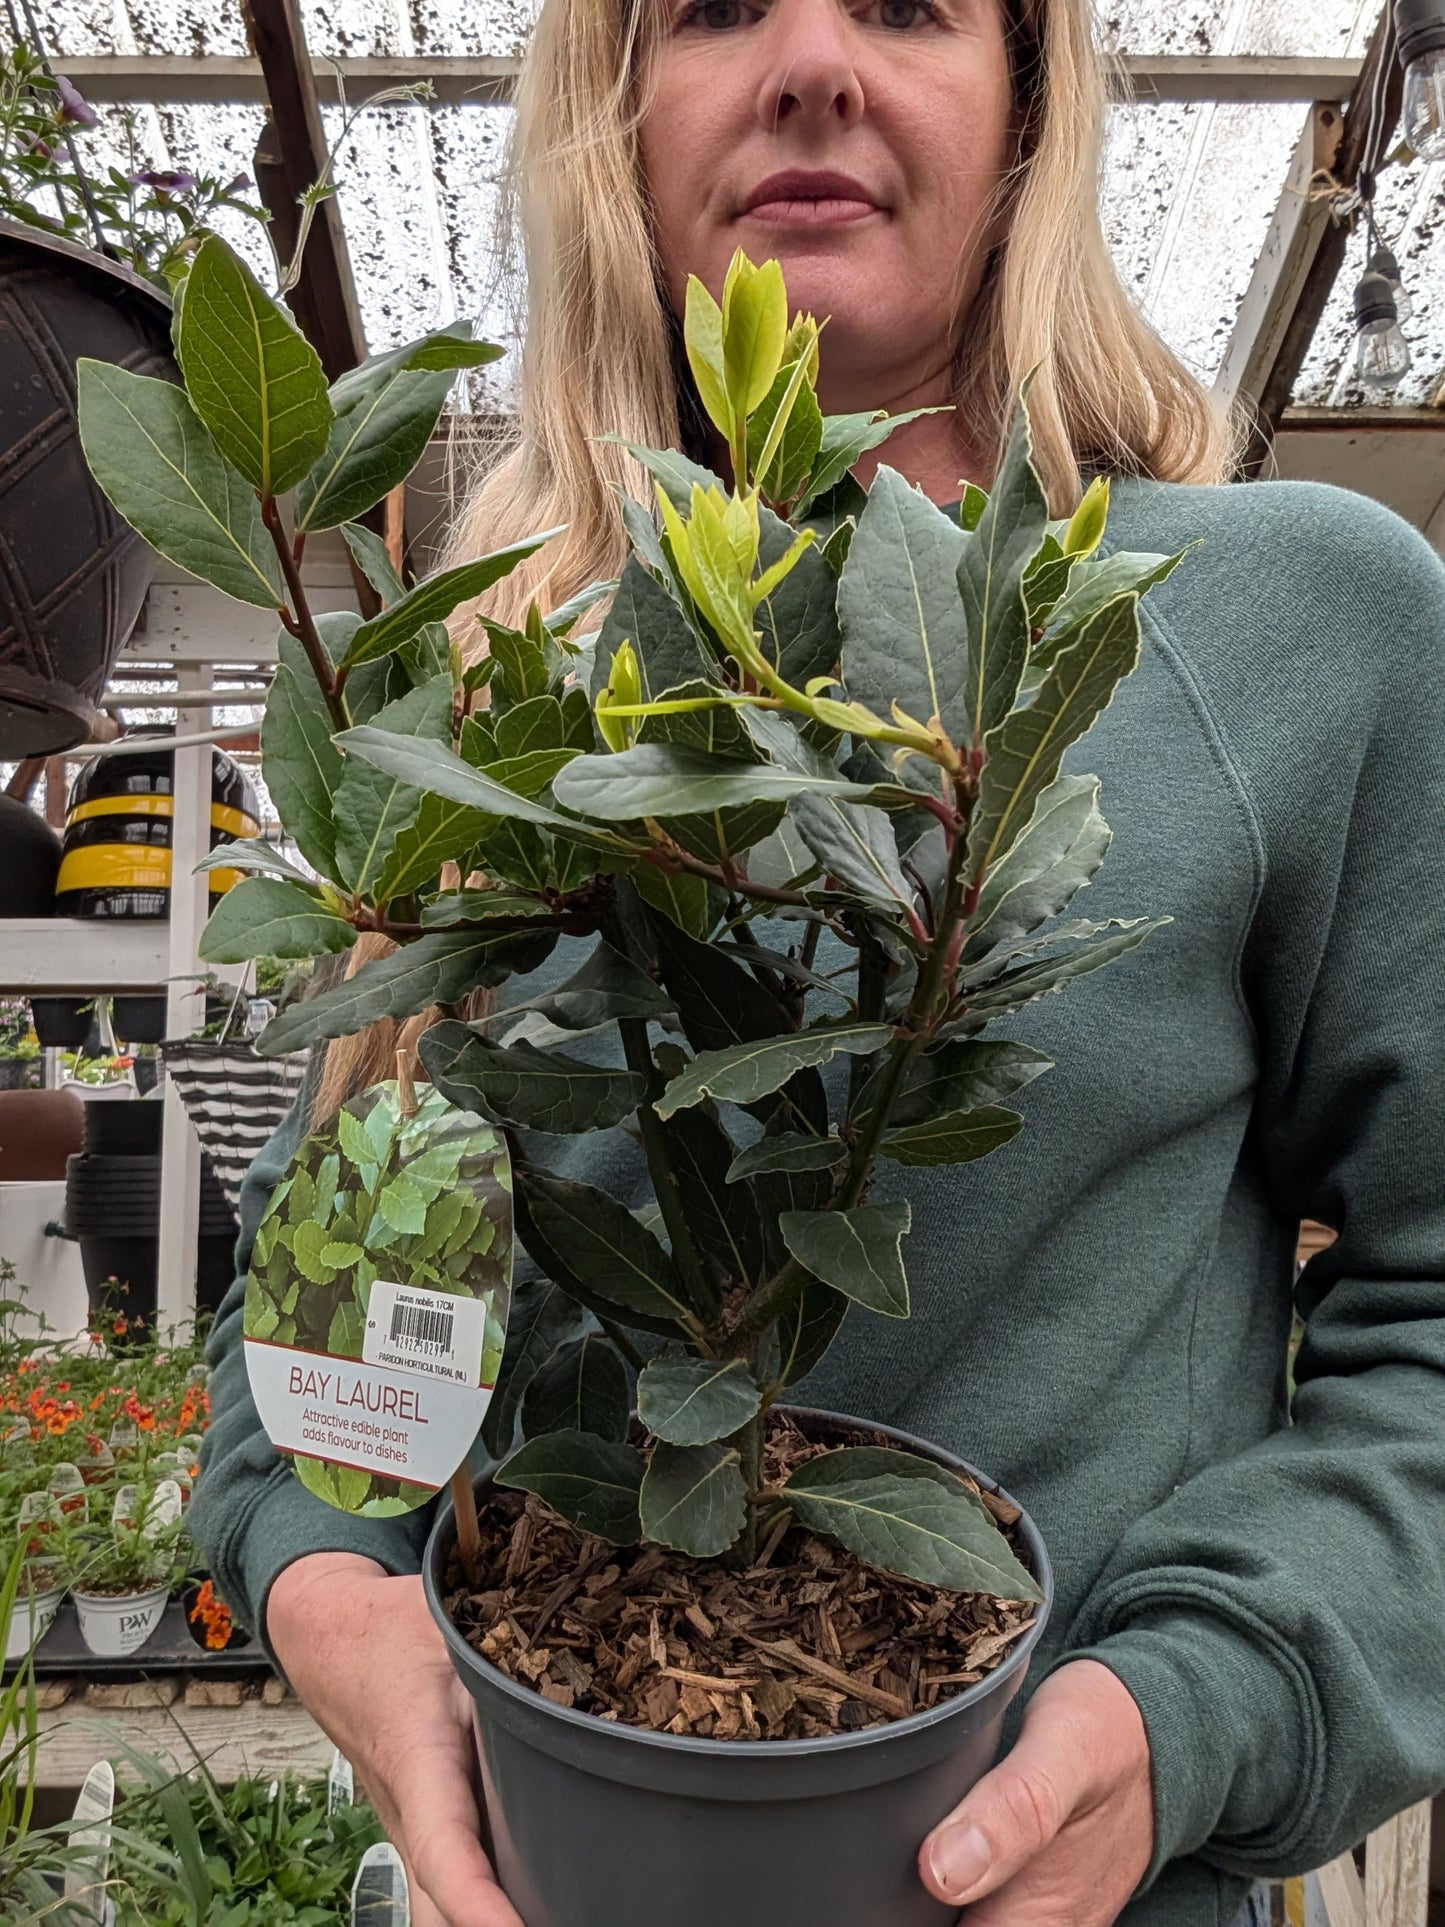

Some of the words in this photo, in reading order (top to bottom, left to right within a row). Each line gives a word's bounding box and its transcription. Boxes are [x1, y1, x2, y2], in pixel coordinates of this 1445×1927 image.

[396, 1292, 414, 1304] Laurus
[415, 1296, 434, 1308] nobilis
[436, 1301, 454, 1311] 17CM
[378, 1352, 404, 1366] PARIDON
[289, 1366, 332, 1401] BAY
[336, 1376, 429, 1424] LAUREL
[302, 1408, 349, 1430] Attractive
[351, 1419, 381, 1438] edible
[382, 1427, 409, 1445] plant
[302, 1427, 326, 1443] adds
[327, 1431, 361, 1451] flavour
[363, 1440, 374, 1455] to
[375, 1444, 408, 1464] dishes
